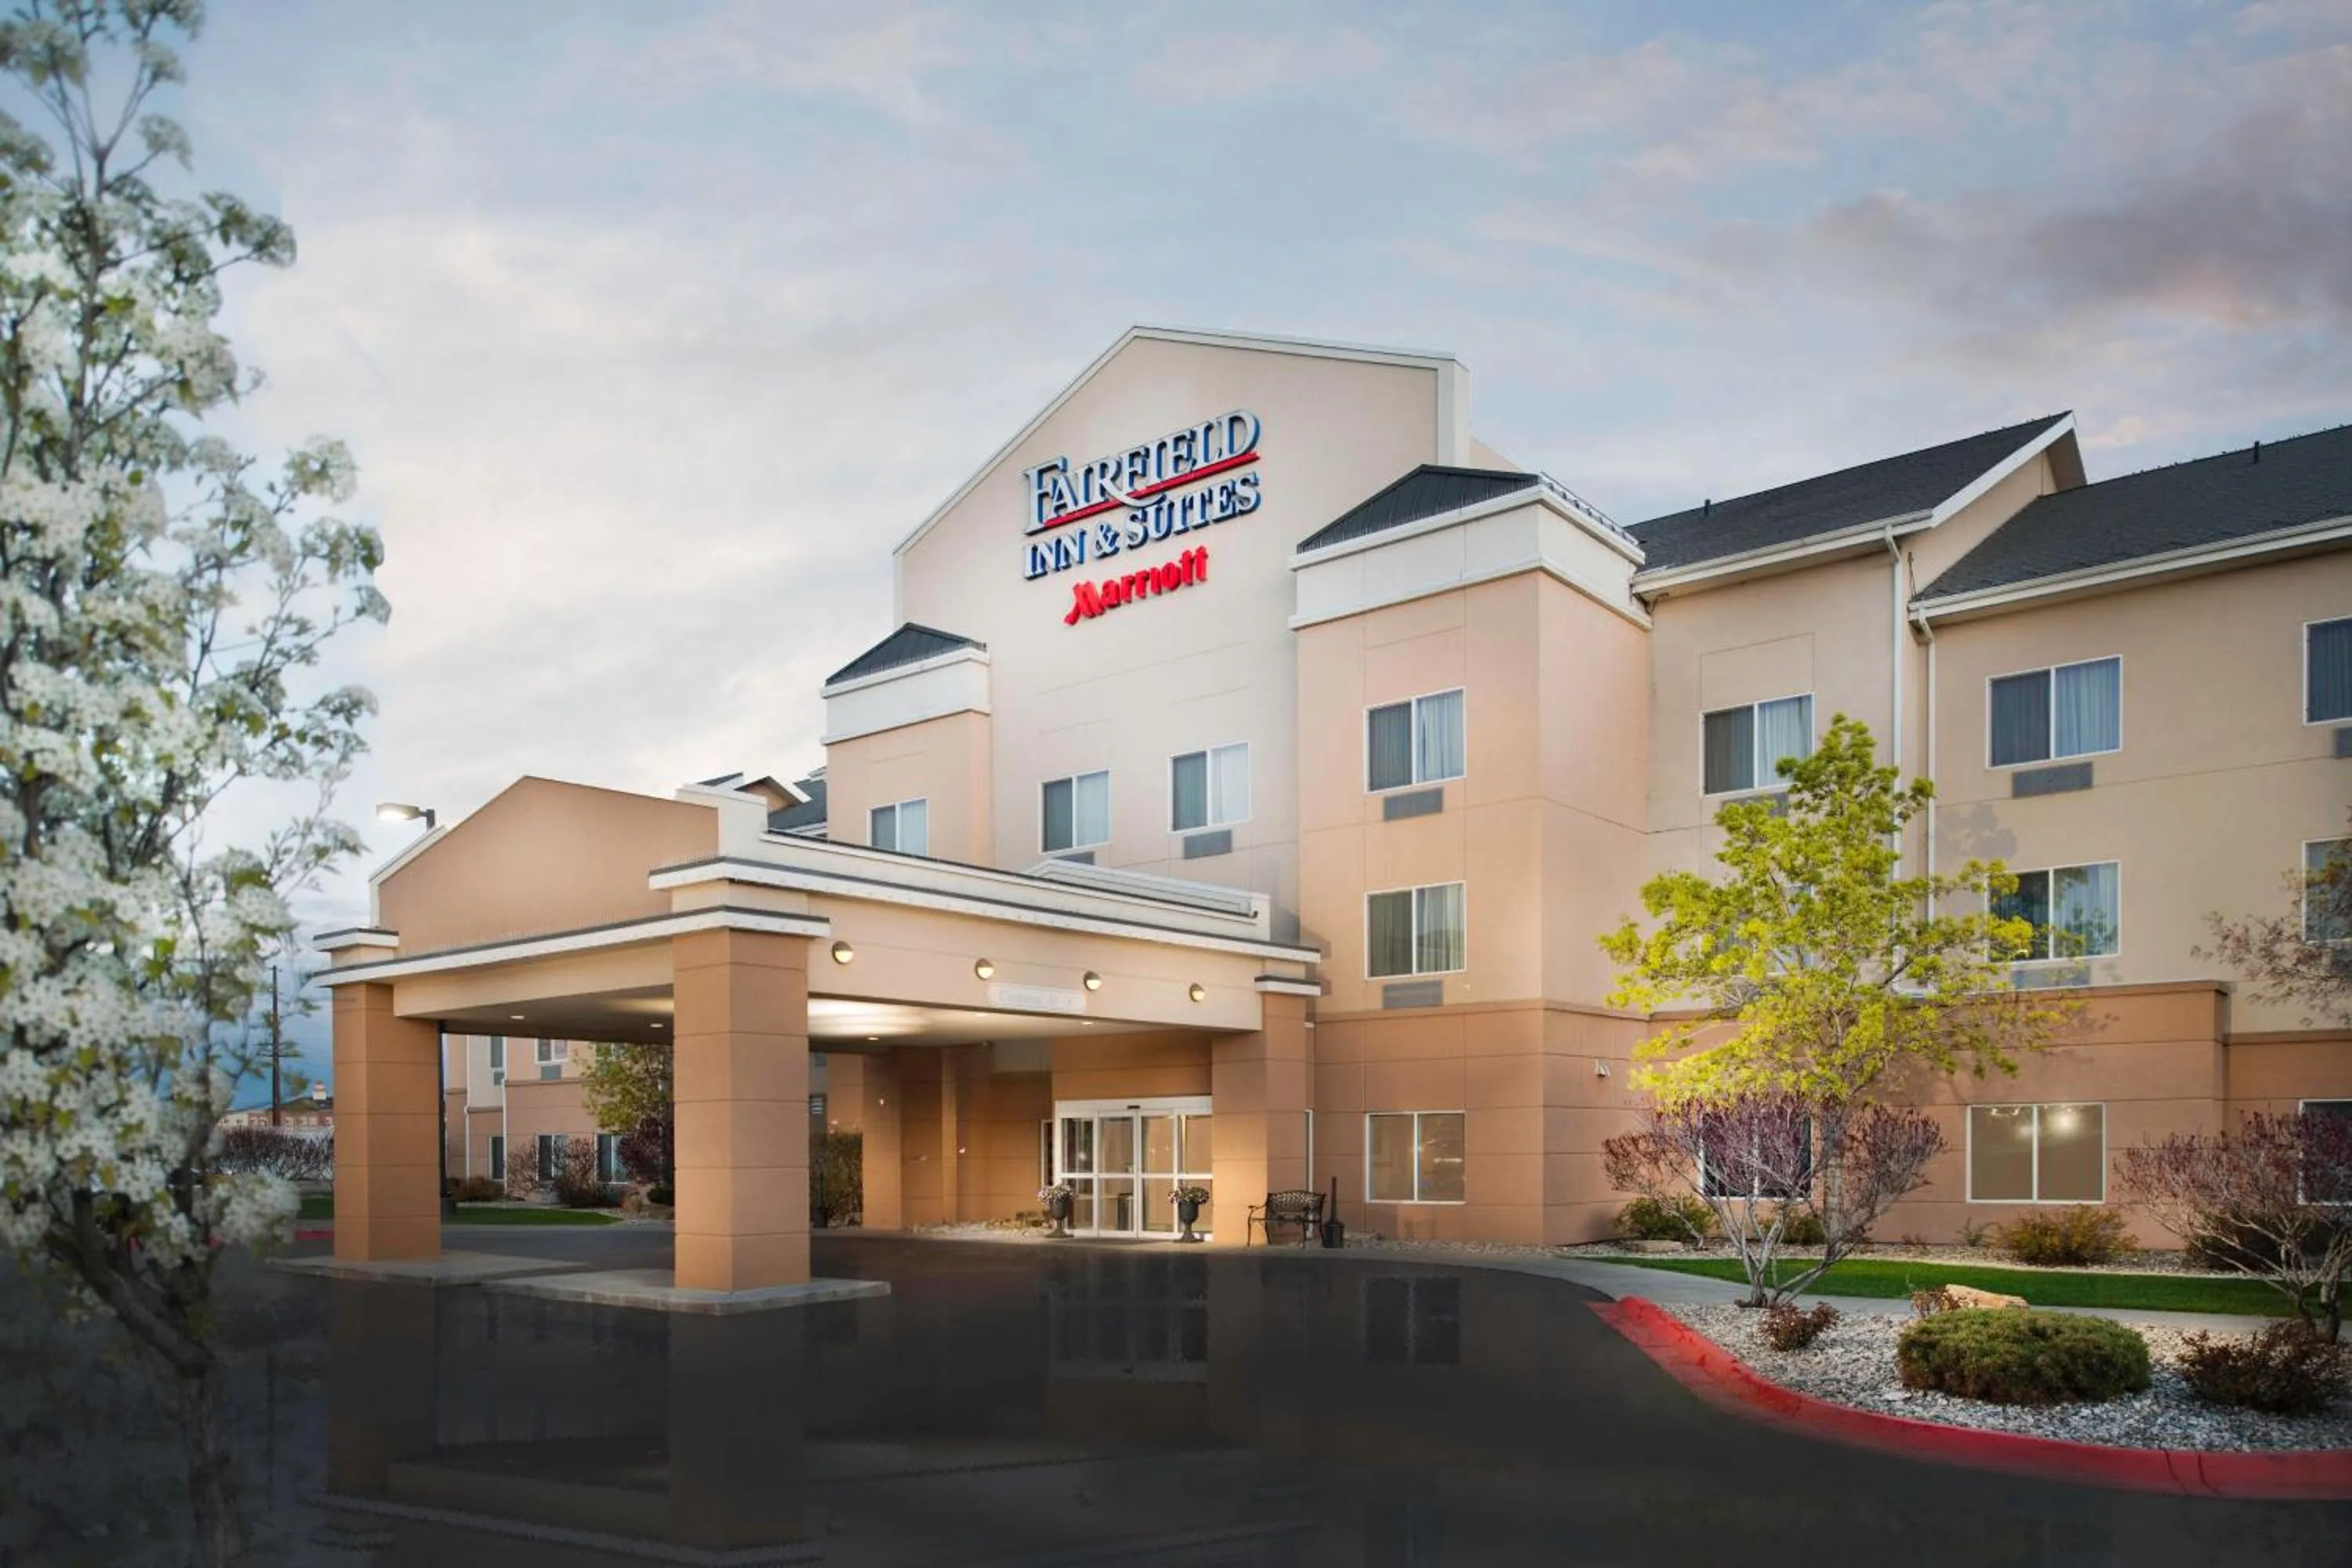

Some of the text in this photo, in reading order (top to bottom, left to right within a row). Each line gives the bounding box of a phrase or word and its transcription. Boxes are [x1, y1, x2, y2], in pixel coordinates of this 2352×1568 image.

[1022, 408, 1261, 535] FAIRFIELD
[1024, 471, 1261, 580] INN & SUITES
[1063, 544, 1209, 626] Marriott
